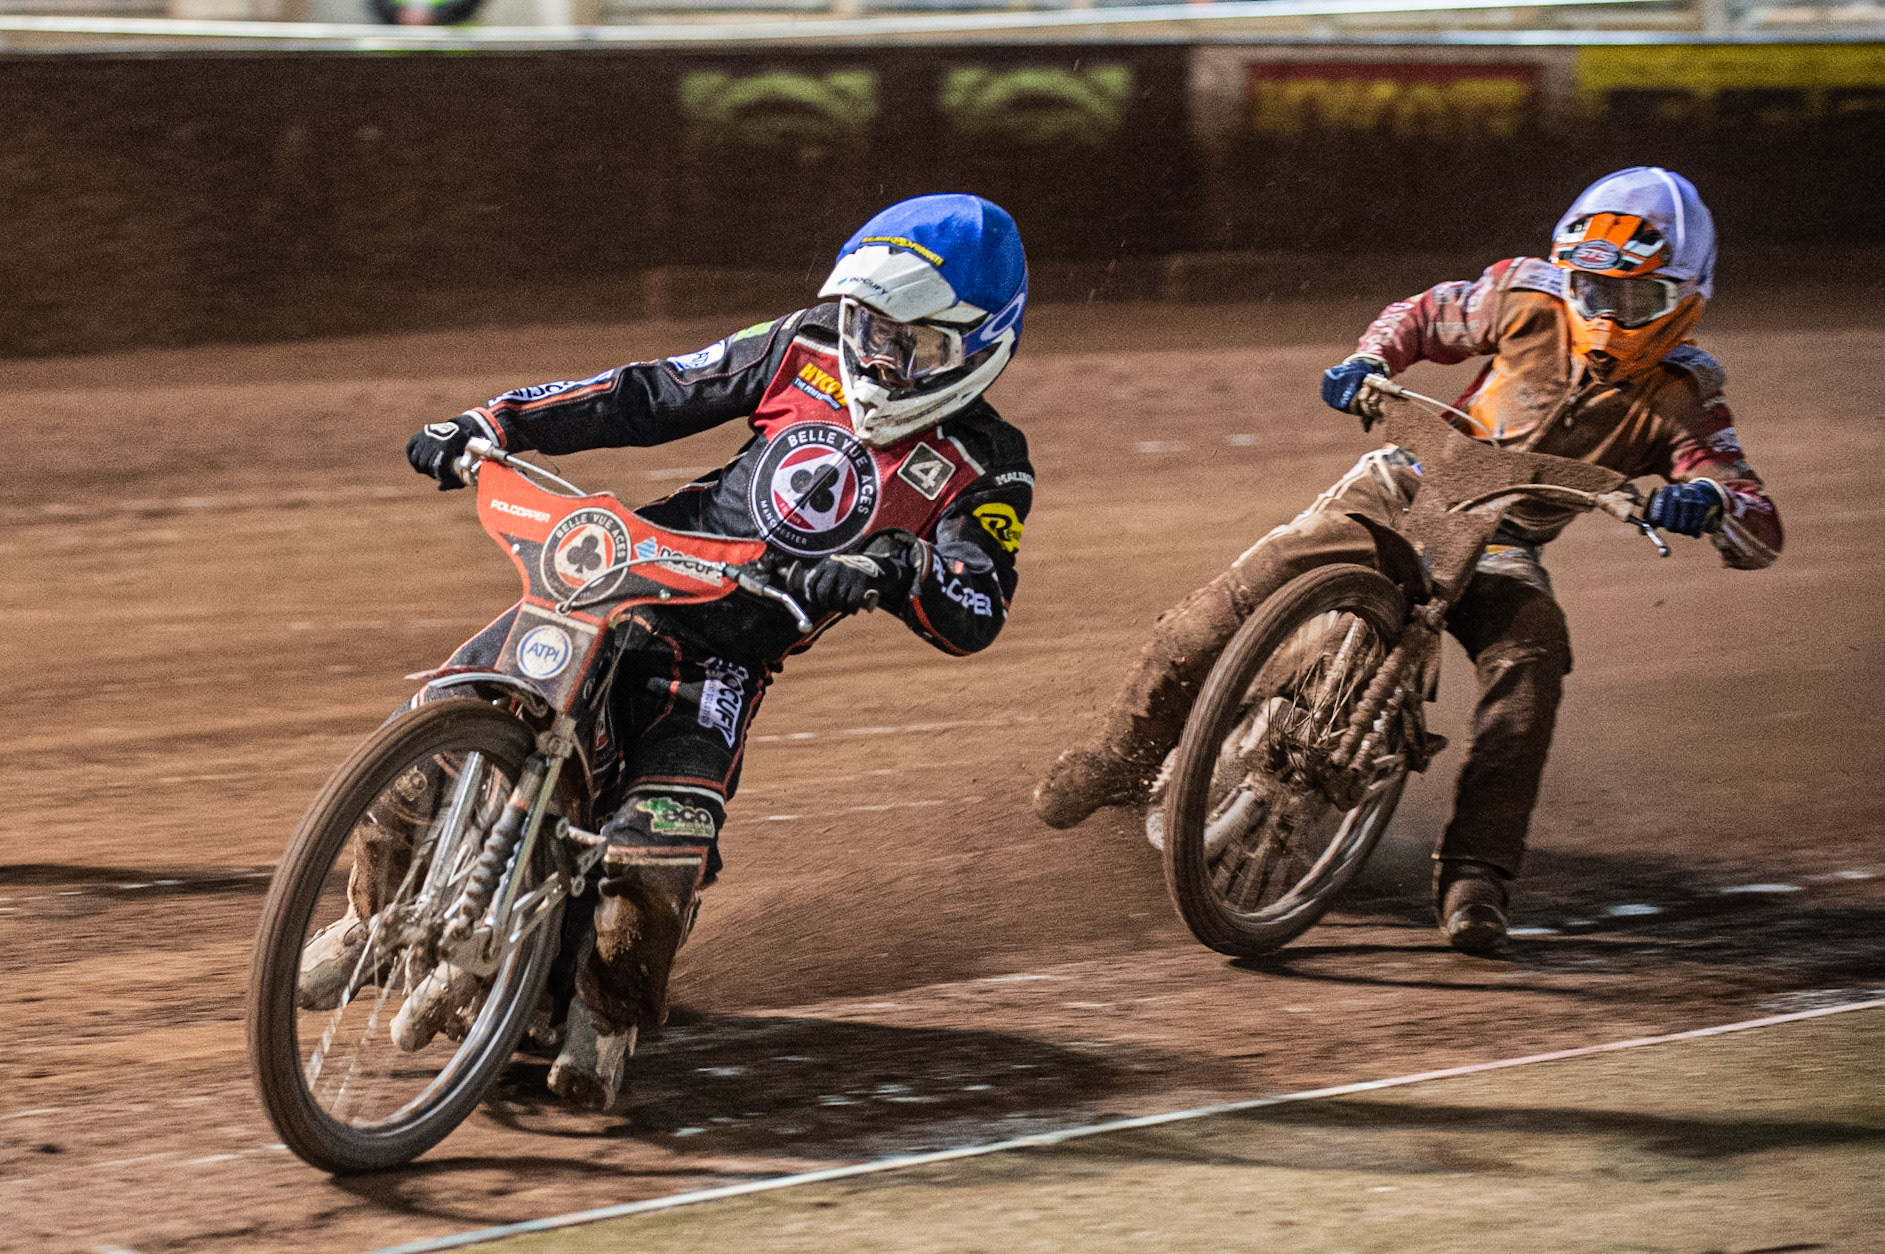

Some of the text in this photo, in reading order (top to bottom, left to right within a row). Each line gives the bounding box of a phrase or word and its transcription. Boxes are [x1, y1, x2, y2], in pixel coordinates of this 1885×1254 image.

[798, 362, 848, 406] HYCO
[787, 429, 837, 447] BELLE
[841, 438, 868, 467] VUE
[857, 474, 874, 515] ACES
[909, 459, 944, 490] 4
[556, 513, 626, 558] BELLE VUE ACES
[526, 642, 560, 662] ATPI
